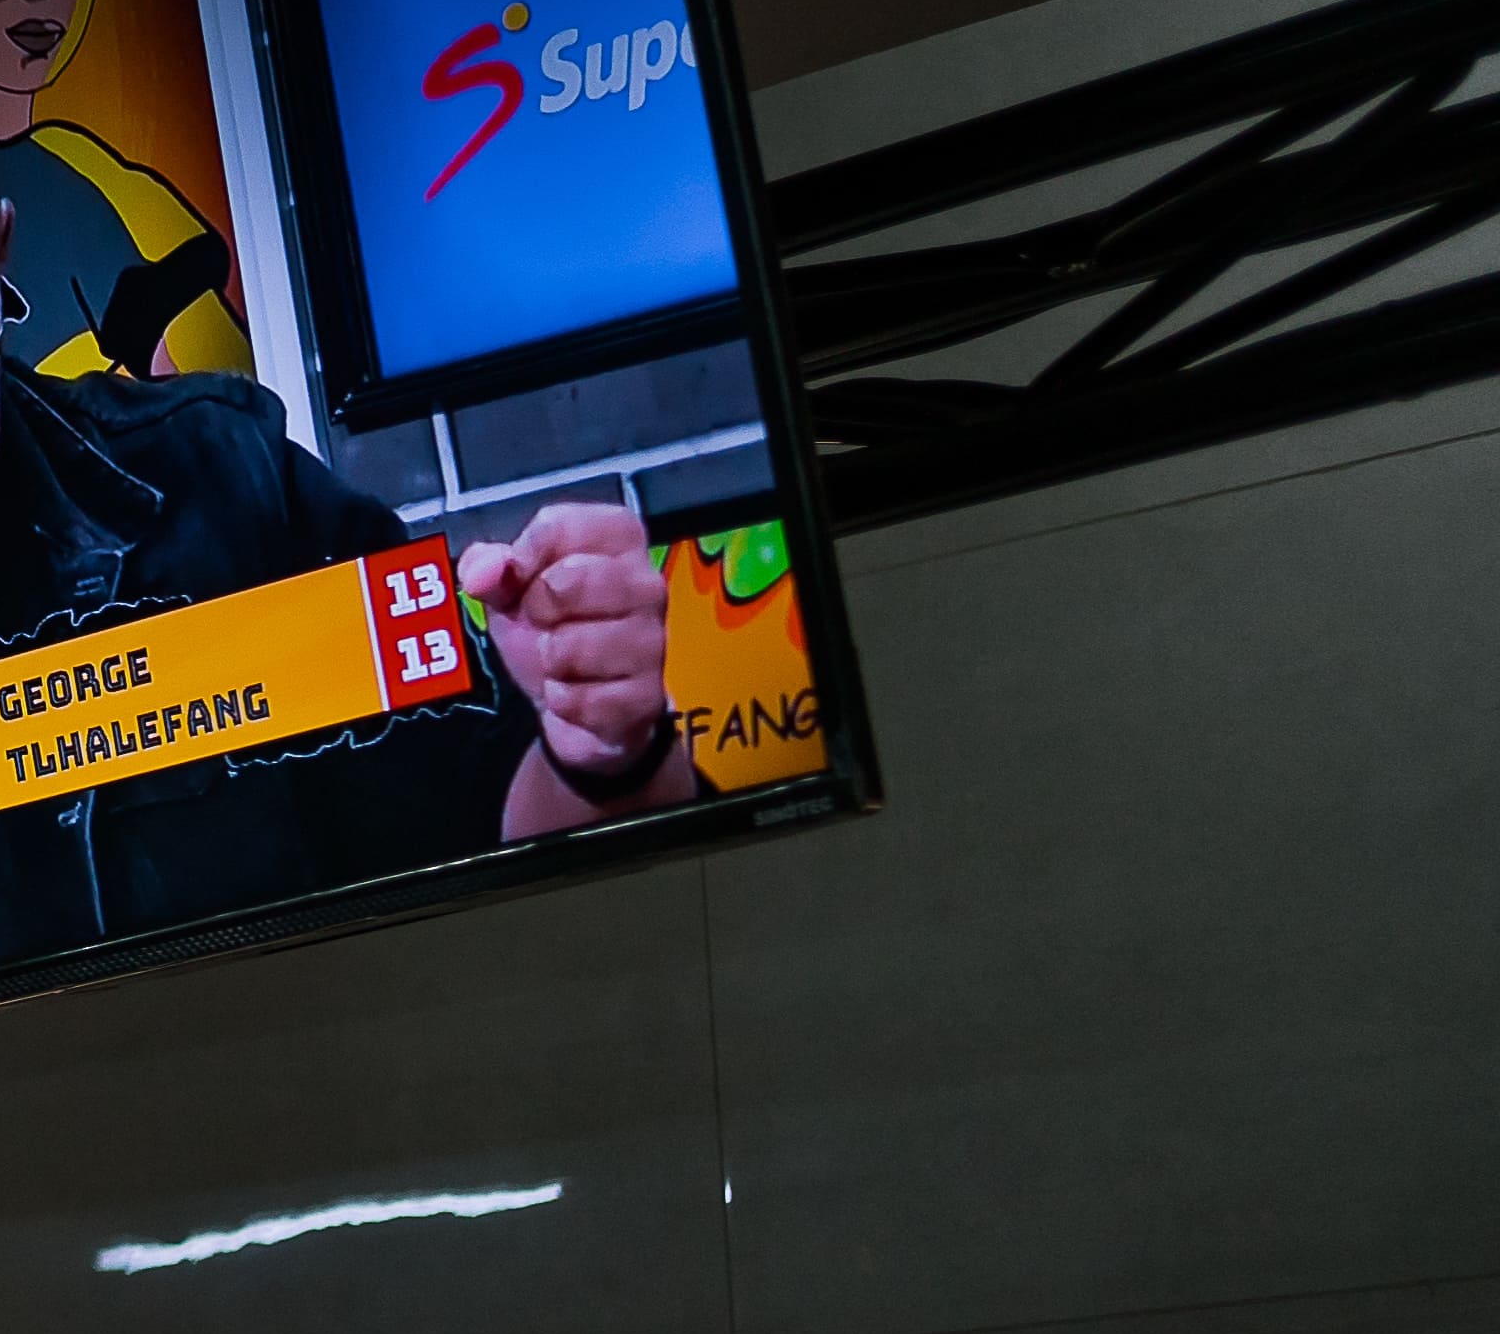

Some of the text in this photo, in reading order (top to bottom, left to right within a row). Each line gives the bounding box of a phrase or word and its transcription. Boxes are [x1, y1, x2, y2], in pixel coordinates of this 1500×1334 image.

[385, 563, 447, 617] 13
[397, 629, 458, 683] 13
[5, 683, 271, 783] TLHALEFANG
